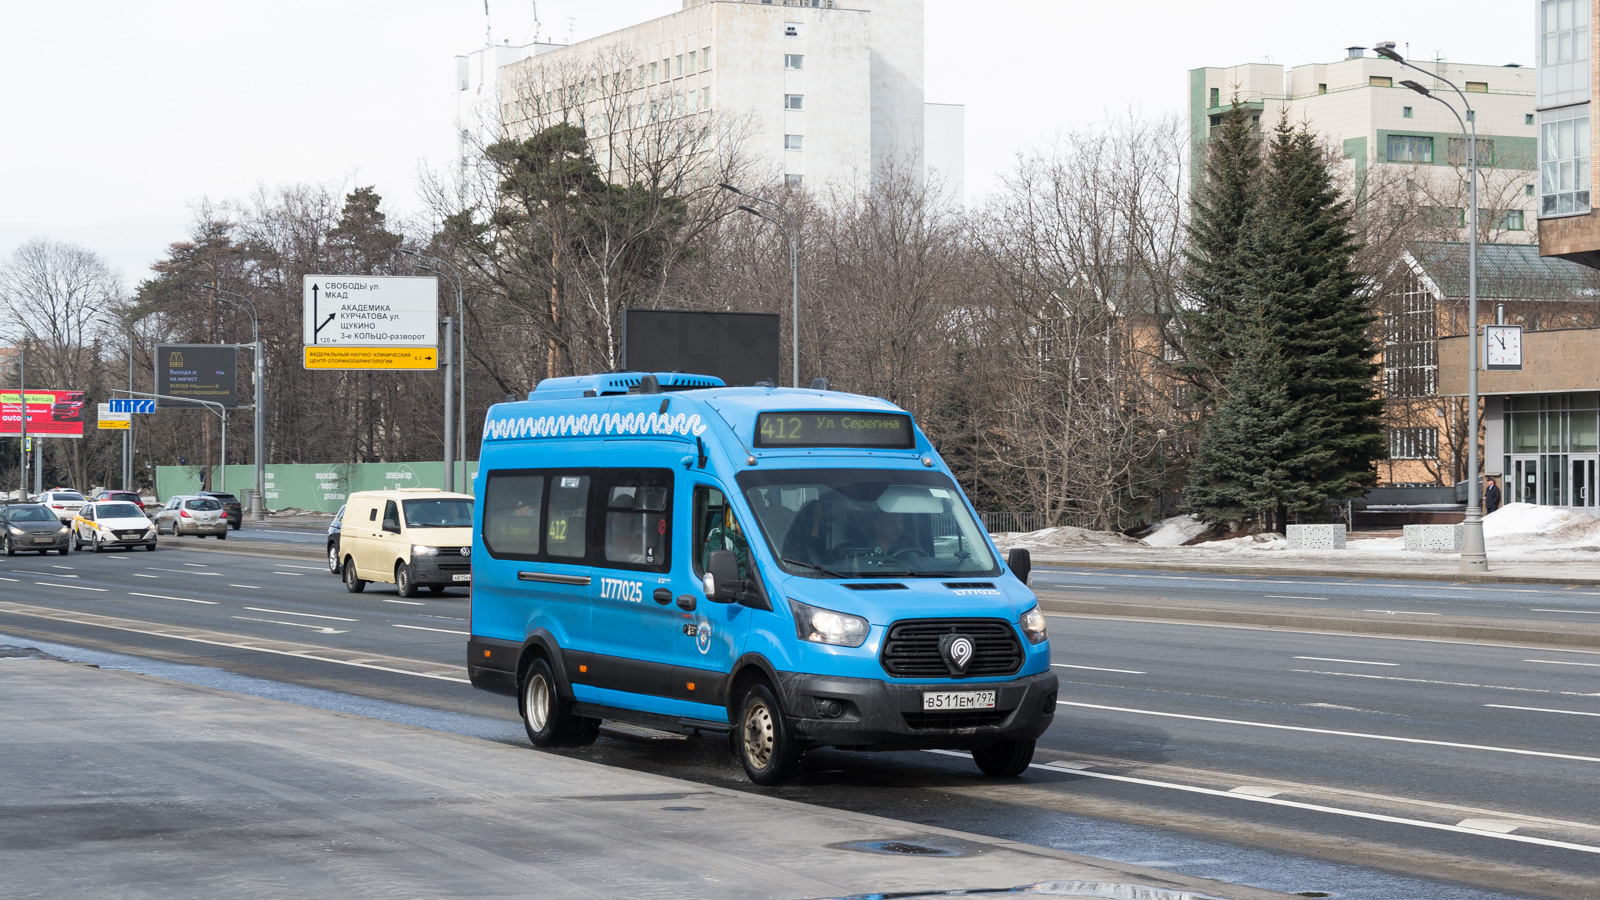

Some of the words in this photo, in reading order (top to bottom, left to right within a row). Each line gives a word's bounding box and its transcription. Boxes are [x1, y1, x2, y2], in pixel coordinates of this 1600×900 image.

[760, 417, 802, 439] 412
[816, 417, 835, 429] Ул.
[842, 417, 900, 430] Серегина
[549, 520, 567, 540] 412
[600, 578, 643, 602] 1777025
[928, 695, 974, 707] В511ЕМ
[976, 693, 992, 702] 797
